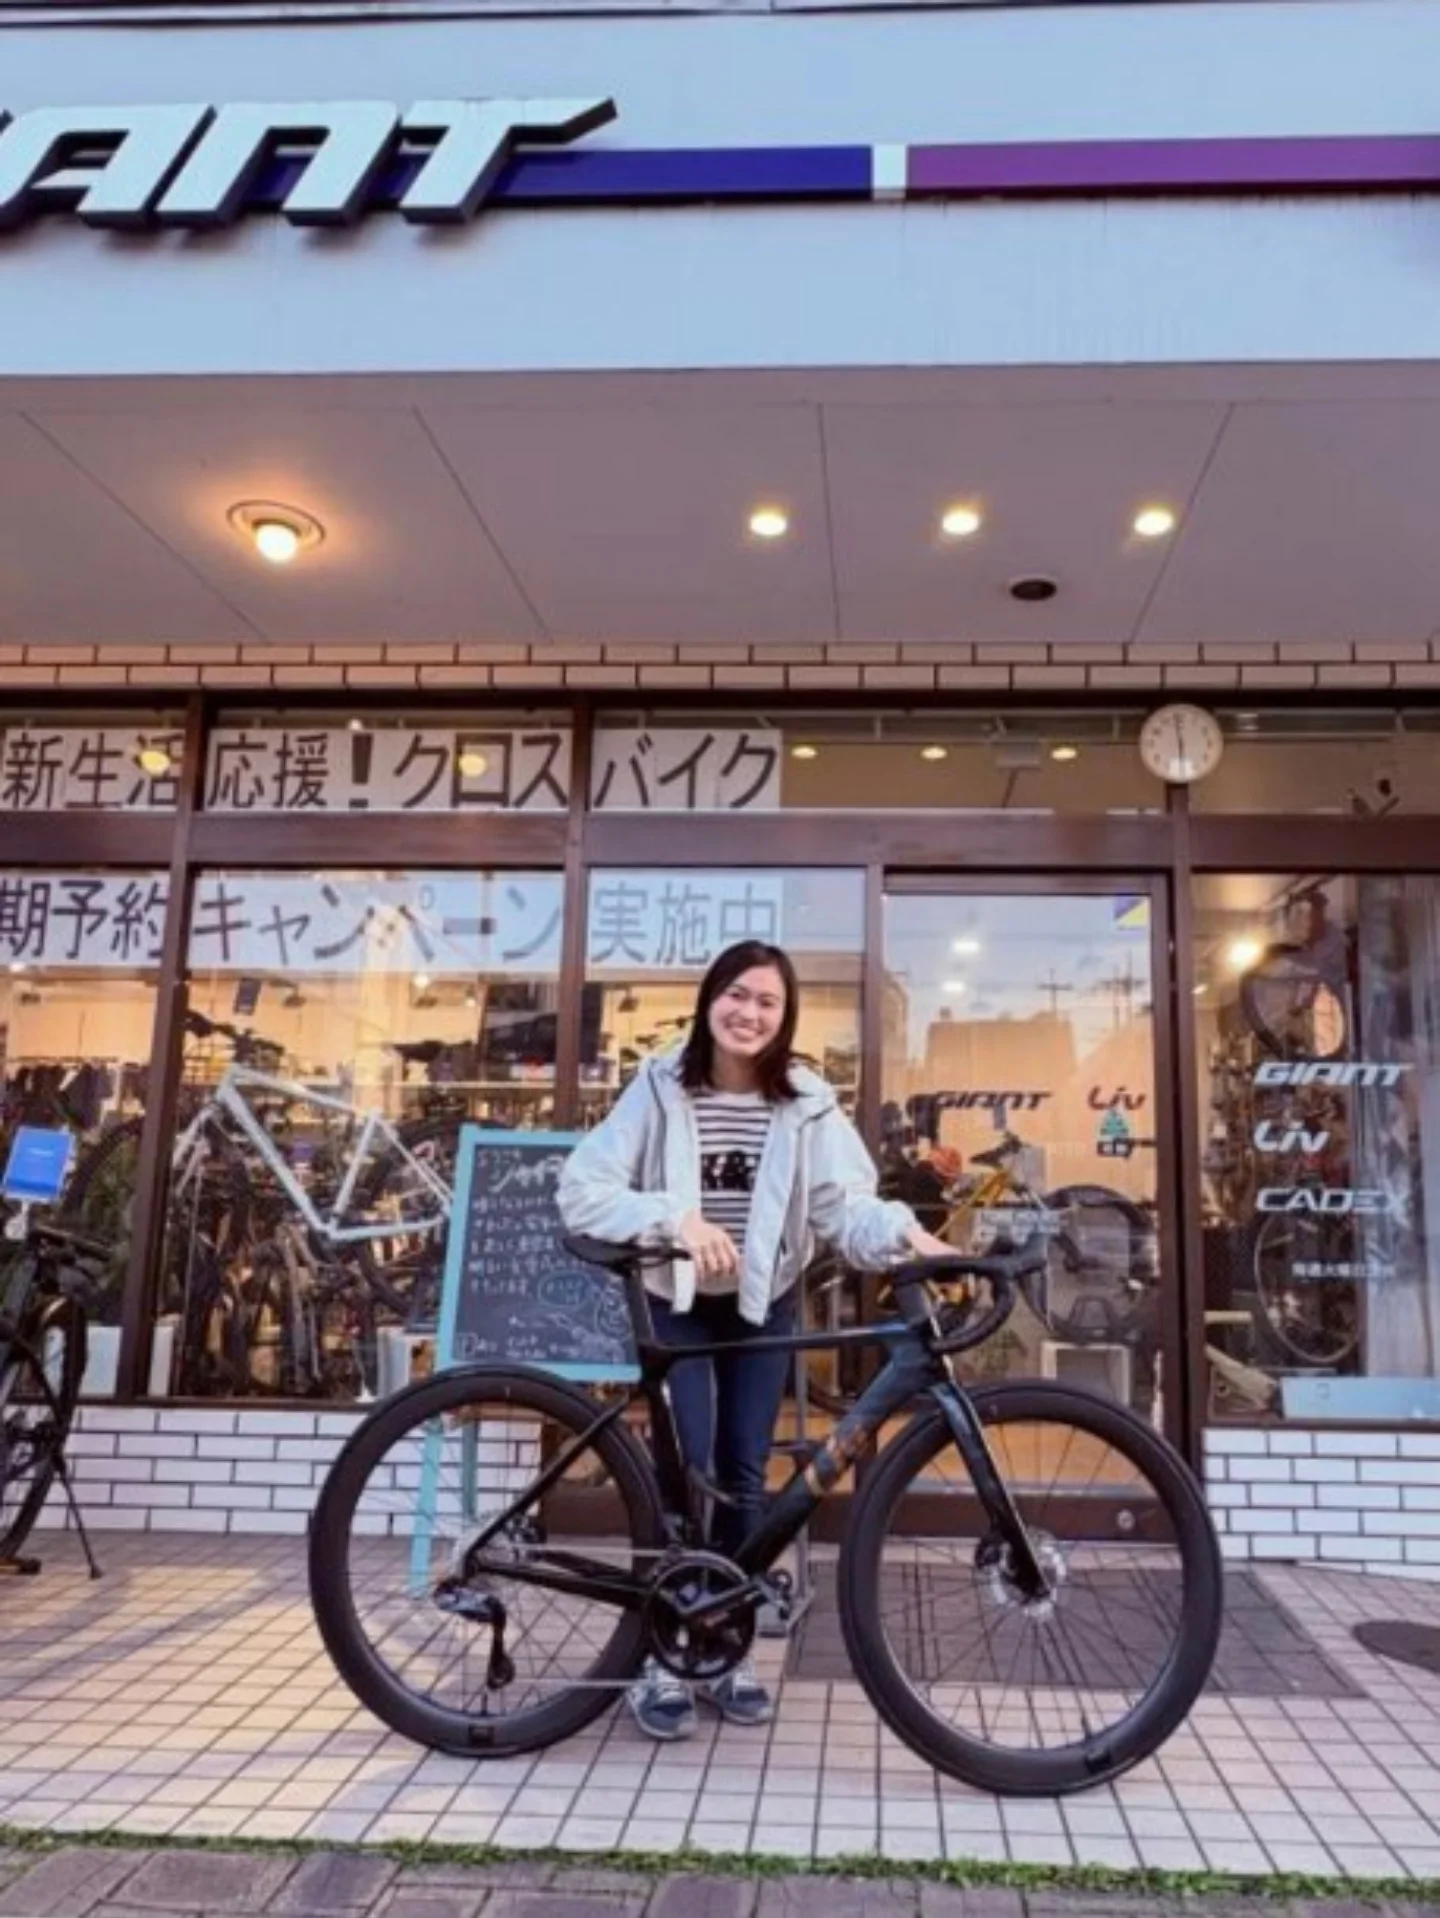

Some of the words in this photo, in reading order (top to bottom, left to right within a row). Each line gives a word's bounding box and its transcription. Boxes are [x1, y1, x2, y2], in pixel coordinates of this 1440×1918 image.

[0, 98, 617, 226] ANT
[1254, 1061, 1415, 1085] GIANT
[935, 1090, 1052, 1110] GIANT
[1088, 1086, 1146, 1110] Liv
[1254, 1120, 1330, 1152] Liv
[1256, 1188, 1411, 1226] CADEX
